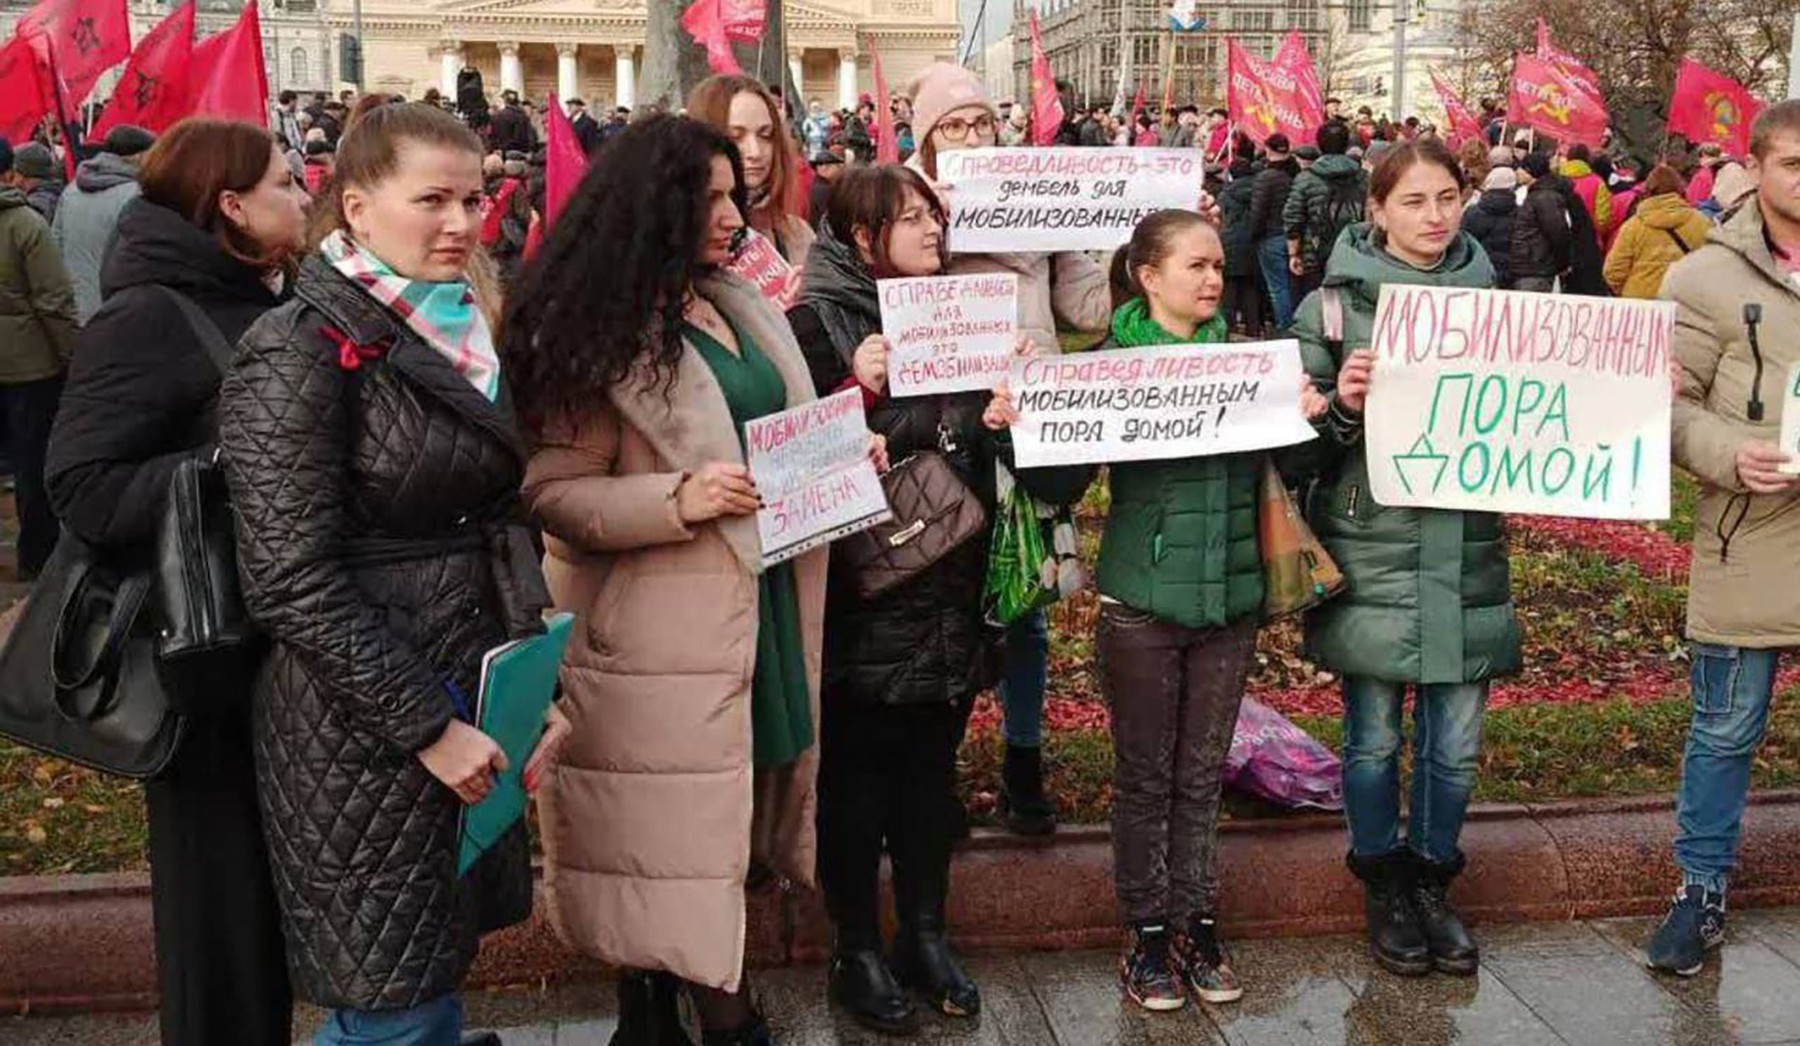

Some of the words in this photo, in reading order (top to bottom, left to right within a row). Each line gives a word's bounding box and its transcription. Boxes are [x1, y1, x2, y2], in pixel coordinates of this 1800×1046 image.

[955, 206, 1159, 229] МОБИЛИЗОВАННЫ
[1018, 380, 1261, 413] МОБИЛИЗОВАННЫМ
[1427, 373, 1570, 441] ПОРА
[1040, 420, 1103, 443] ПОРА
